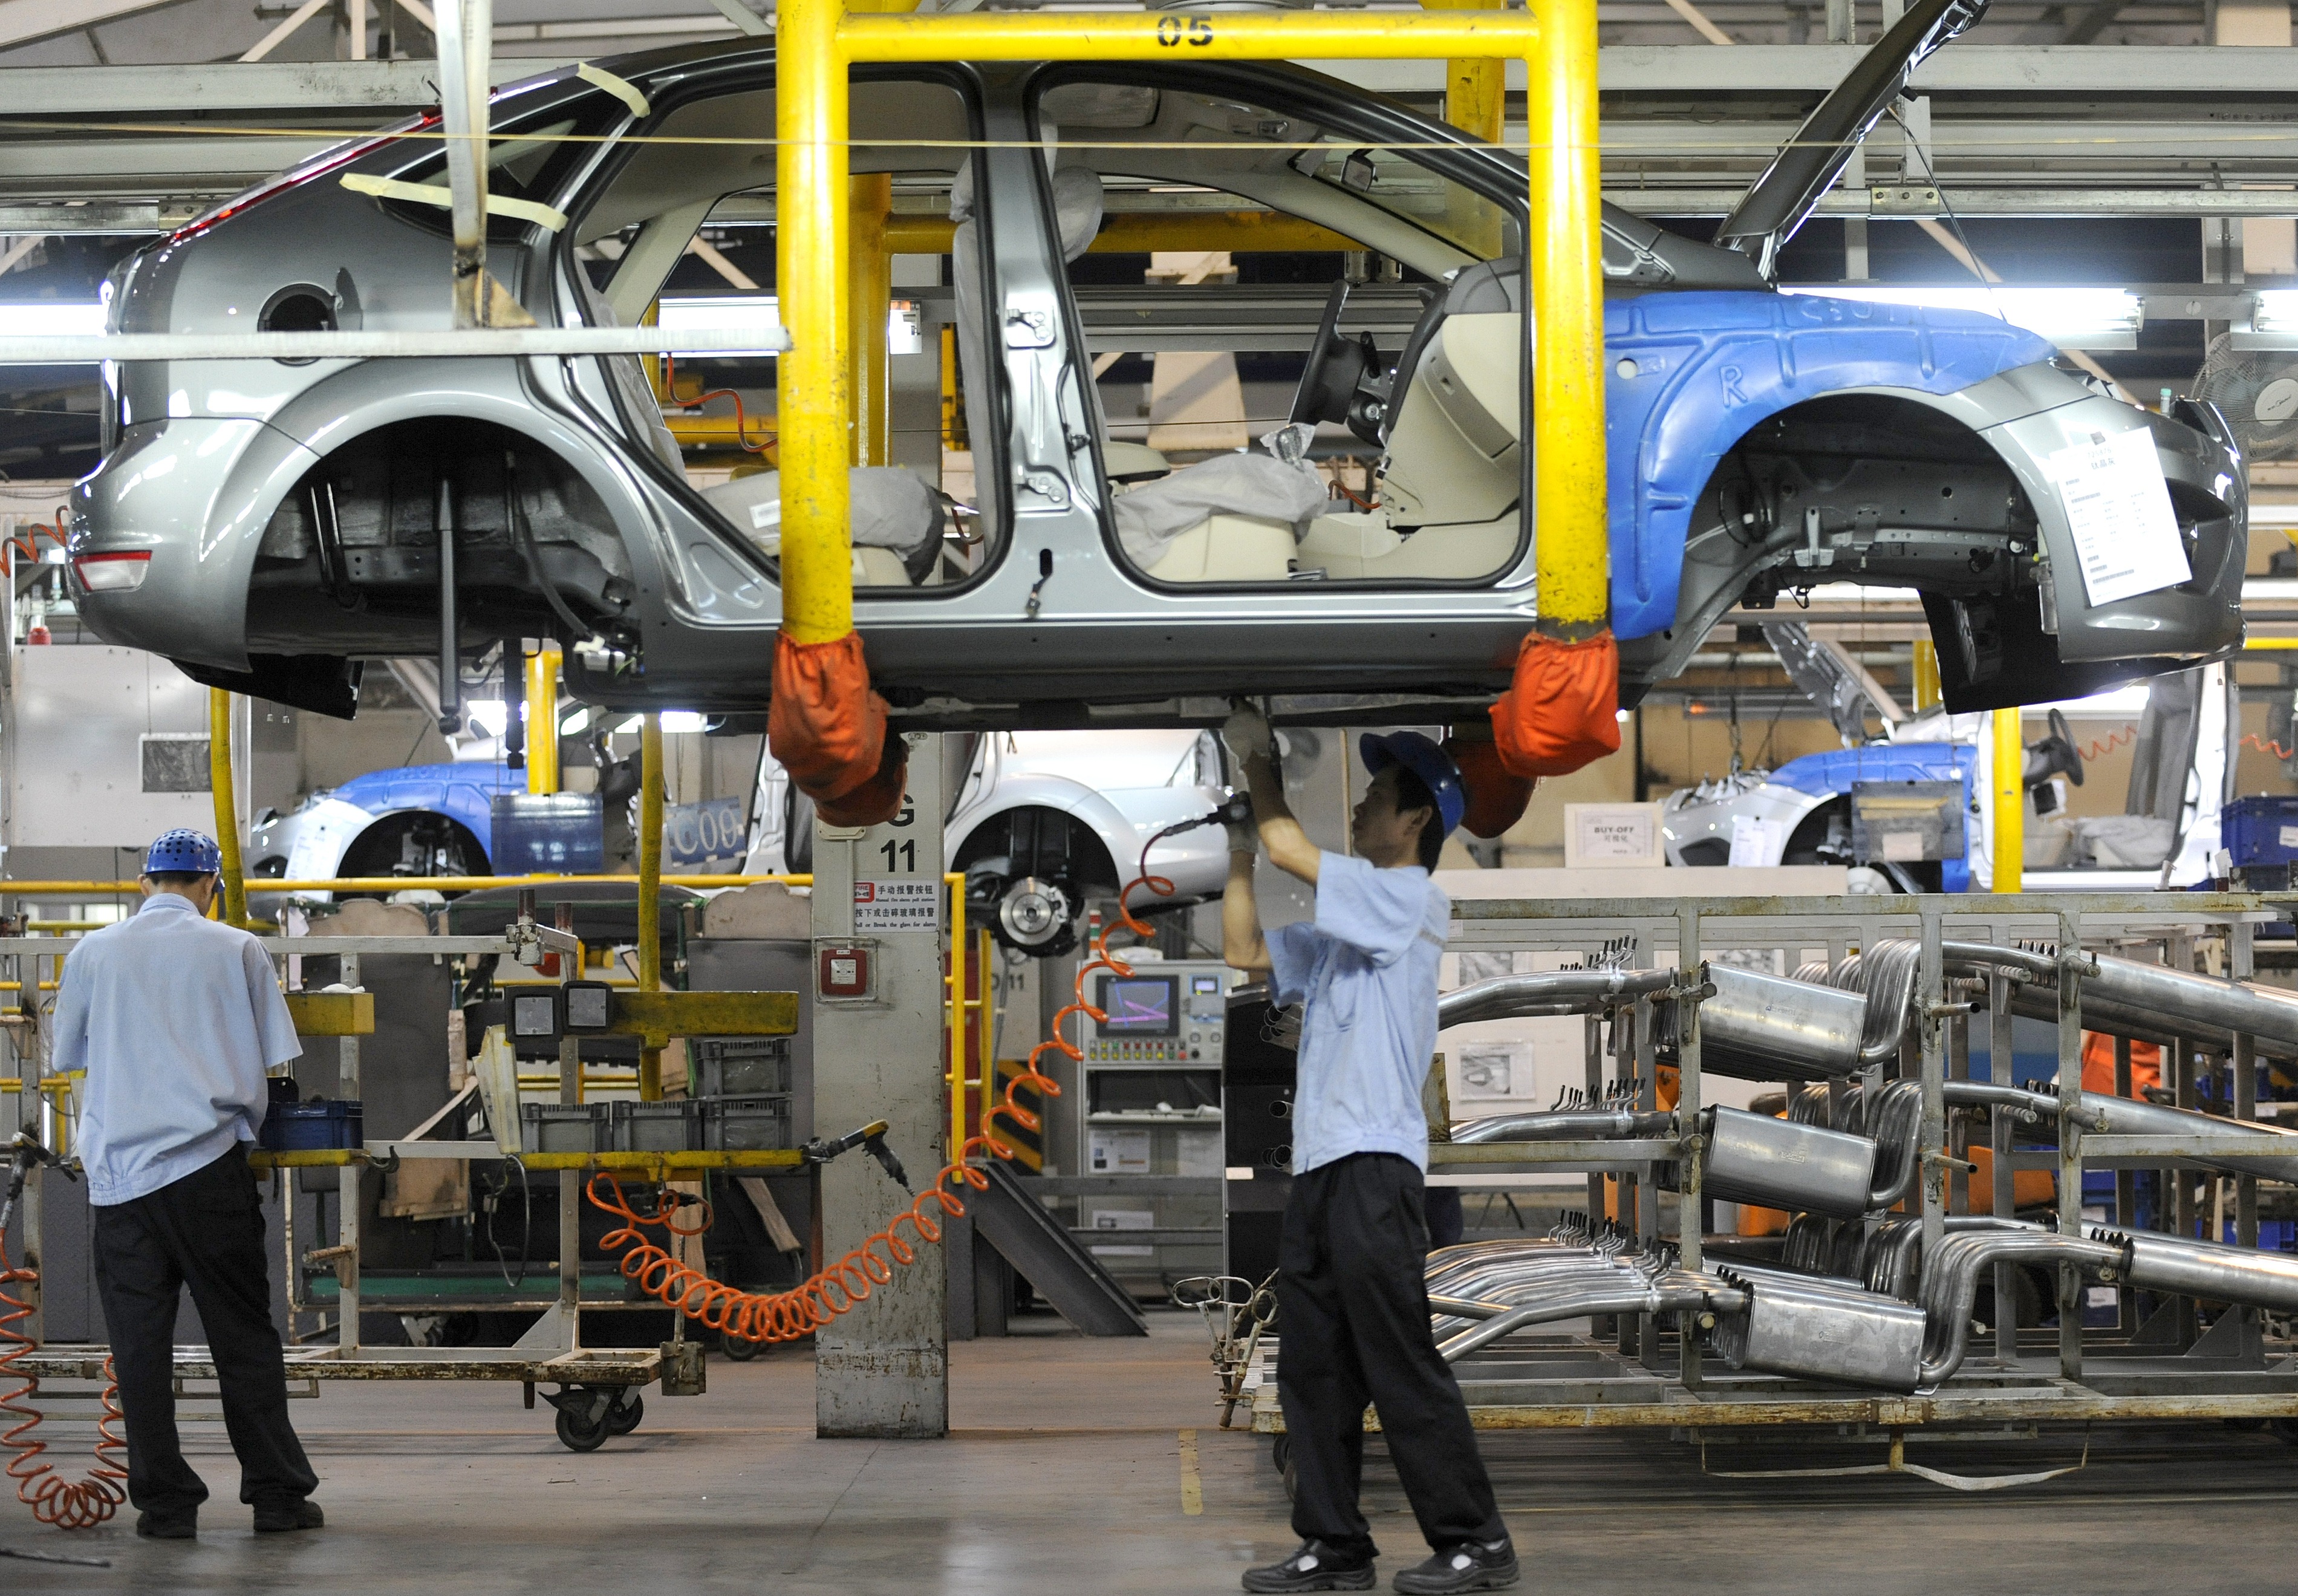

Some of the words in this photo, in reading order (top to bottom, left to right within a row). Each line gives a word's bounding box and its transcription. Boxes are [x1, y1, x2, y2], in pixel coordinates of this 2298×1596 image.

[1157, 16, 1213, 46] 05
[1719, 365, 1748, 408] R
[888, 794, 914, 827] G
[880, 839, 914, 872] 11
[878, 885, 933, 895] 手动报警按钮
[856, 908, 934, 917] 按下或击碎玻璃报警
